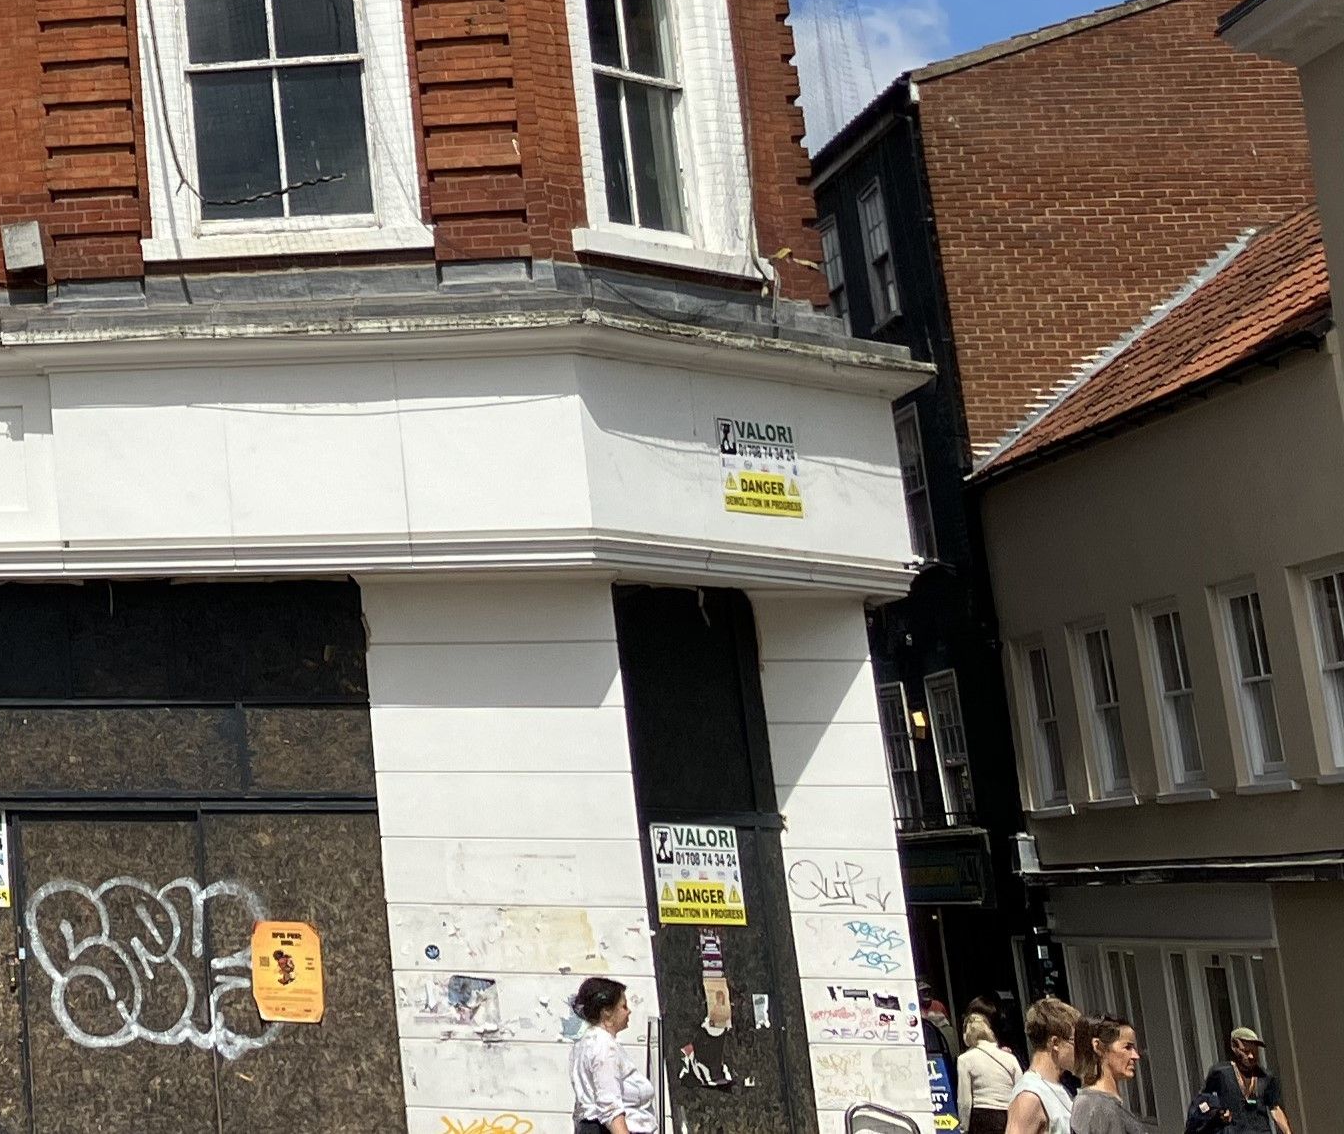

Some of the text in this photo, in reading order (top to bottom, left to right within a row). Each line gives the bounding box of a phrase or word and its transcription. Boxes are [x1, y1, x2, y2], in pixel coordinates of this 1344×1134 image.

[735, 420, 793, 443] VALORI
[740, 478, 785, 496] DANGER
[726, 495, 802, 512] DEMOLITION IN PROGRESS
[673, 827, 735, 848] VALORI
[676, 852, 736, 867] 01708 74 34 24
[677, 888, 725, 904] DANGER
[661, 907, 744, 919] DEMOLITION IN PROGRESS
